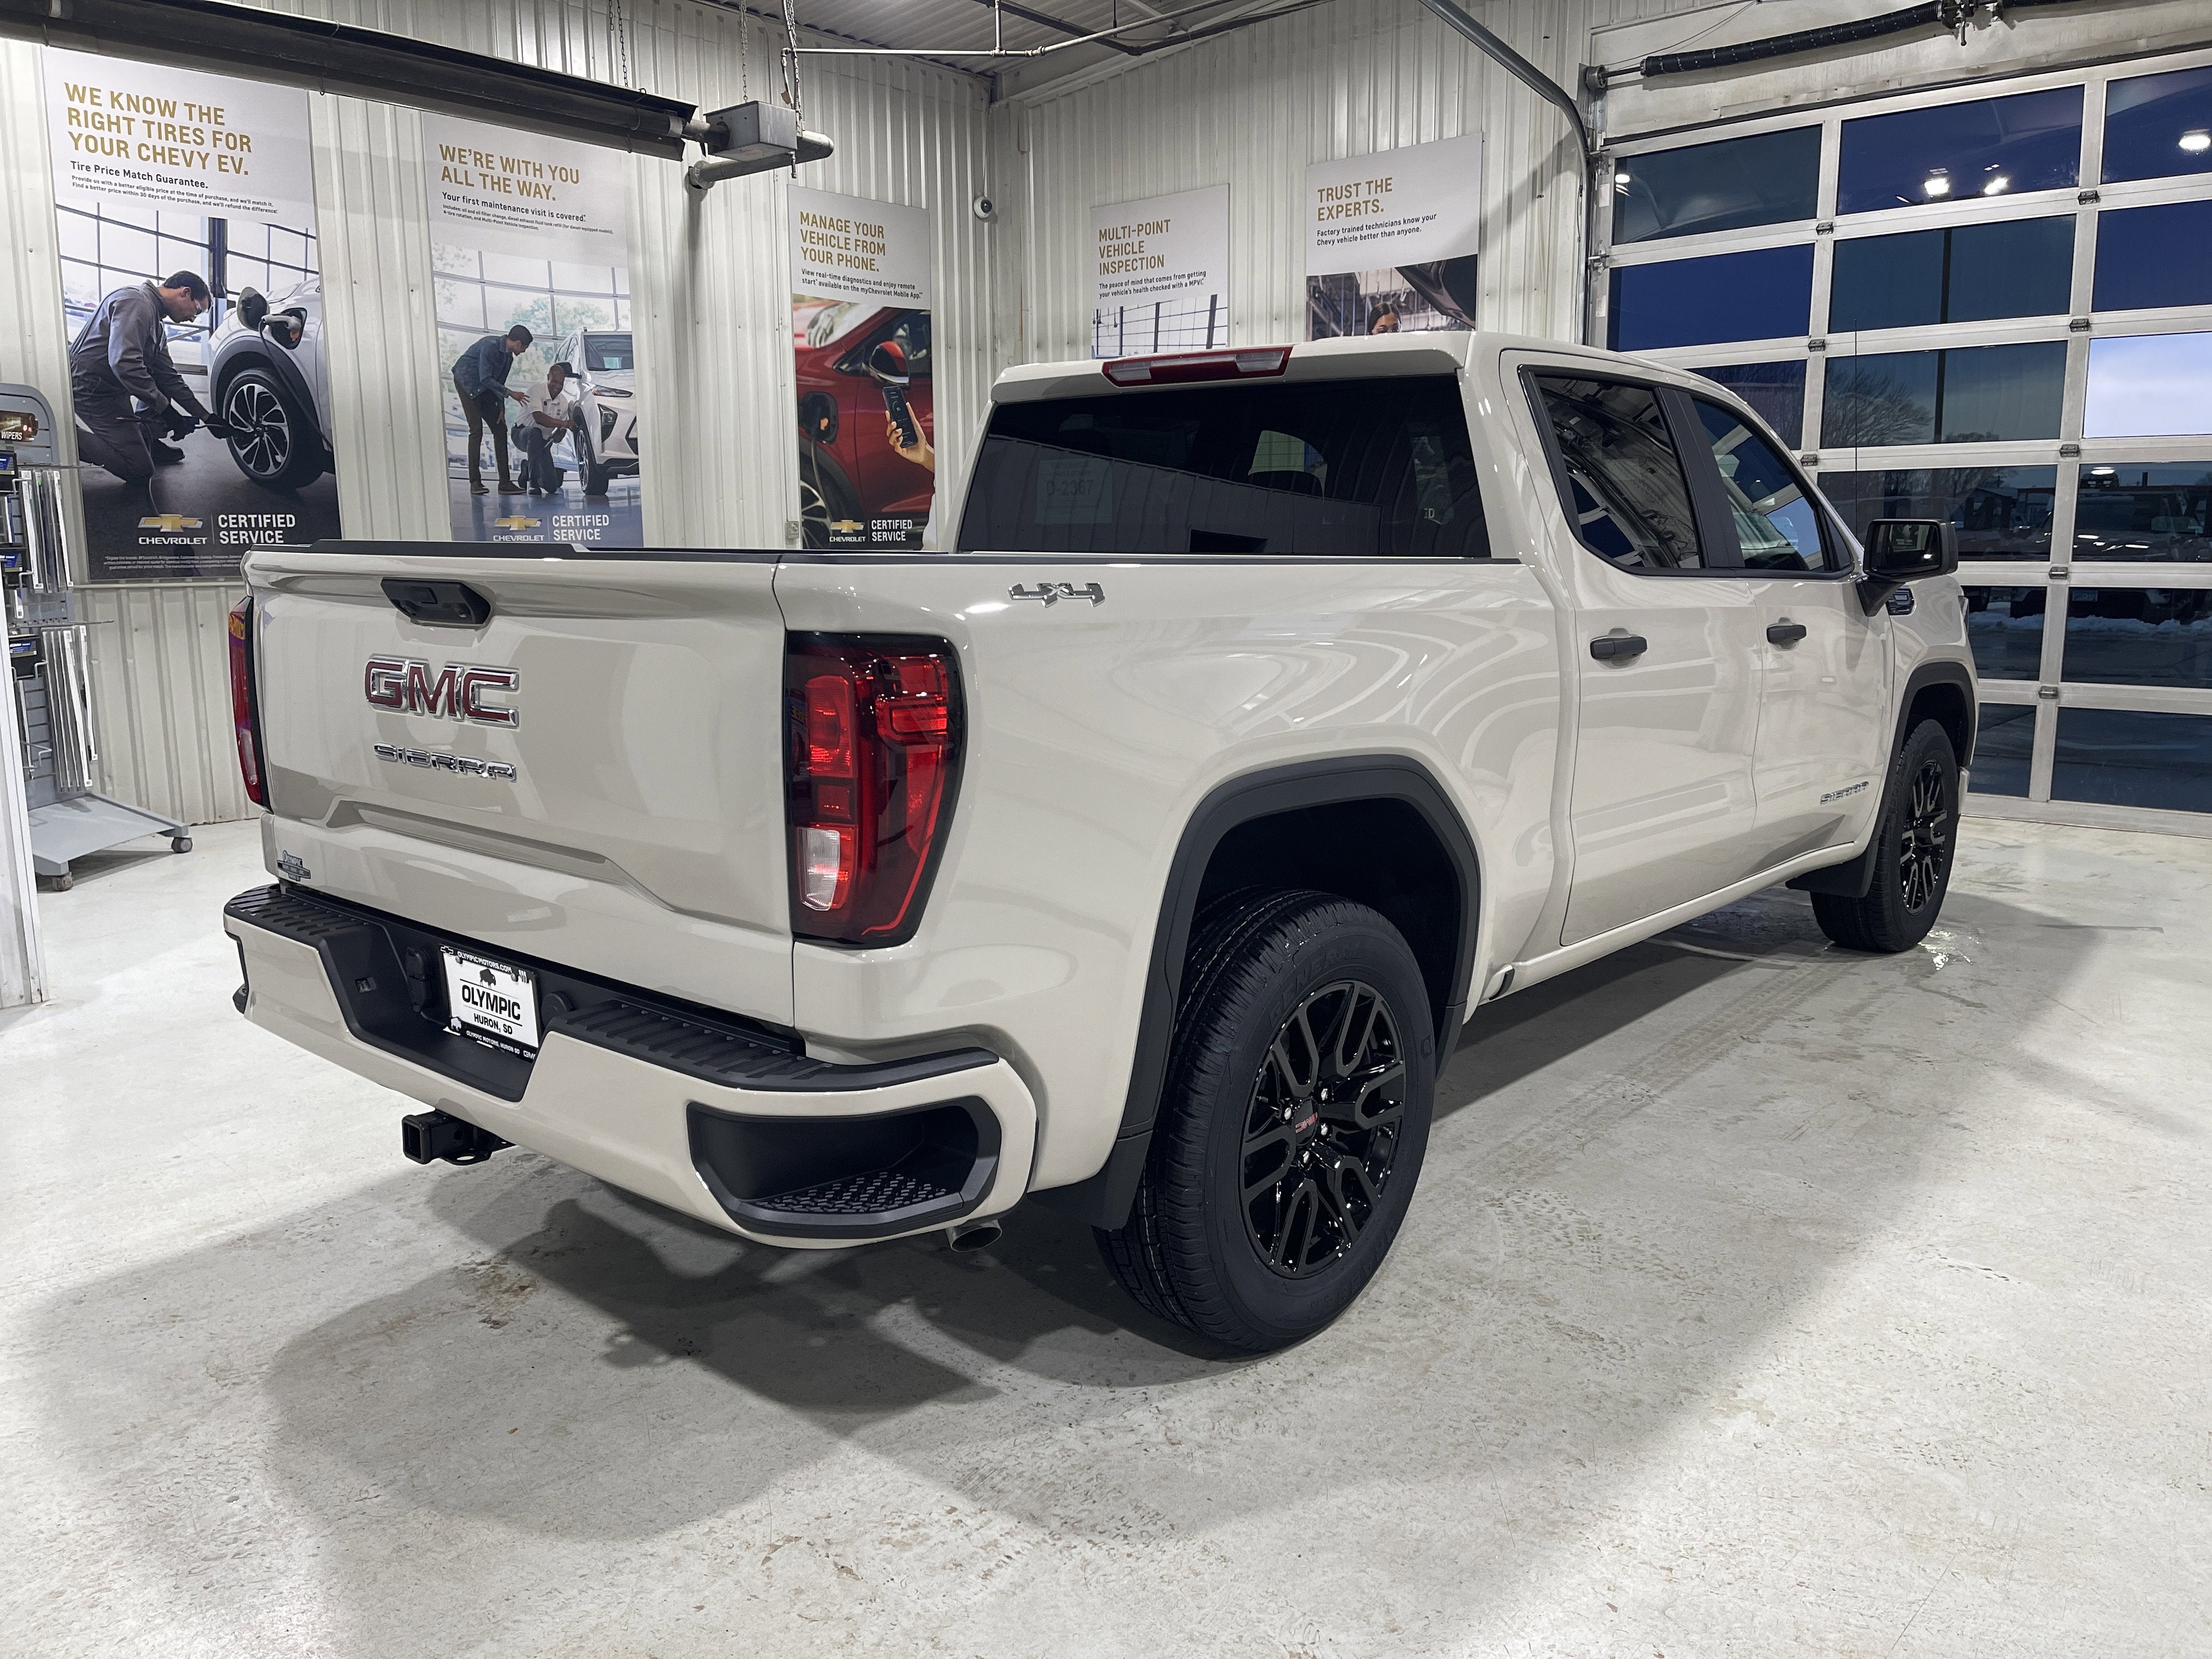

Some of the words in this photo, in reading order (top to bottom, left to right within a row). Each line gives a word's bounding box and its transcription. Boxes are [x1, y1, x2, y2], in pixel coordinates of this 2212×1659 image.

[64, 83, 102, 106] WE
[110, 92, 177, 117] KNOW
[184, 103, 225, 126] THE
[67, 108, 136, 134] RIGHT
[142, 120, 205, 145] TIRES
[212, 131, 252, 153] FOR
[68, 132, 130, 158] YOUR
[138, 143, 210, 169] CHEVY
[217, 155, 249, 175] EV.
[70, 161, 91, 172] Tire
[94, 165, 120, 176] Price
[123, 170, 153, 181] Match
[156, 174, 208, 188] Guarantee.
[500, 156, 543, 178] WITH
[548, 165, 579, 184] YOU
[441, 166, 475, 187] ALL
[478, 173, 512, 194] THE
[516, 180, 556, 201] WAY.
[1317, 183, 1361, 202] TRUST
[1365, 177, 1392, 195] THE
[442, 192, 460, 201] Your
[462, 195, 479, 206] first
[482, 201, 529, 213] maintenance
[531, 208, 546, 217] visit
[1318, 199, 1384, 221] EXPERTS.
[800, 212, 850, 233] MANAGE
[854, 222, 884, 239] YOUR
[1099, 219, 1171, 241] MULTI-POINT
[1342, 224, 1363, 233] trained
[1365, 220, 1401, 230] technicians
[1421, 214, 1437, 223] your
[800, 229, 851, 250] VEHICLE
[855, 239, 885, 256] FROM
[1337, 235, 1358, 244] vehicle
[1397, 227, 1421, 236] anyone.
[800, 247, 833, 264] YOUR
[837, 253, 879, 272] PHONE.
[1099, 241, 1144, 258] VEHICLE
[1099, 255, 1164, 275] INSPECTION
[1187, 271, 1206, 280] getting
[816, 272, 841, 280] real-time
[842, 275, 872, 285] diagnostics
[1150, 283, 1171, 291] checked
[860, 286, 893, 296] myChevrolet
[1, 431, 22, 441] WIPERS
[218, 514, 296, 528] CERTIFIED
[552, 514, 610, 528] CERTIFIED
[871, 520, 912, 530] CERTIFIED
[138, 537, 207, 545] CHEVROLET
[219, 530, 284, 544] SERVICE
[553, 529, 601, 541] SERVICE
[872, 531, 906, 542] SERVICE
[364, 658, 520, 728] GMC
[374, 742, 517, 782] SIERRA
[1820, 781, 1869, 804] SIERRA
[457, 951, 512, 973] OLYMPICMOTORS.COM
[462, 985, 521, 1020] OLYMPIC
[474, 1013, 501, 1032] HURON,
[503, 1024, 513, 1035] SD
[466, 1030, 482, 1041] OLYMPIC
[523, 1050, 535, 1060] GM
[1295, 1111, 1318, 1133] GMC
